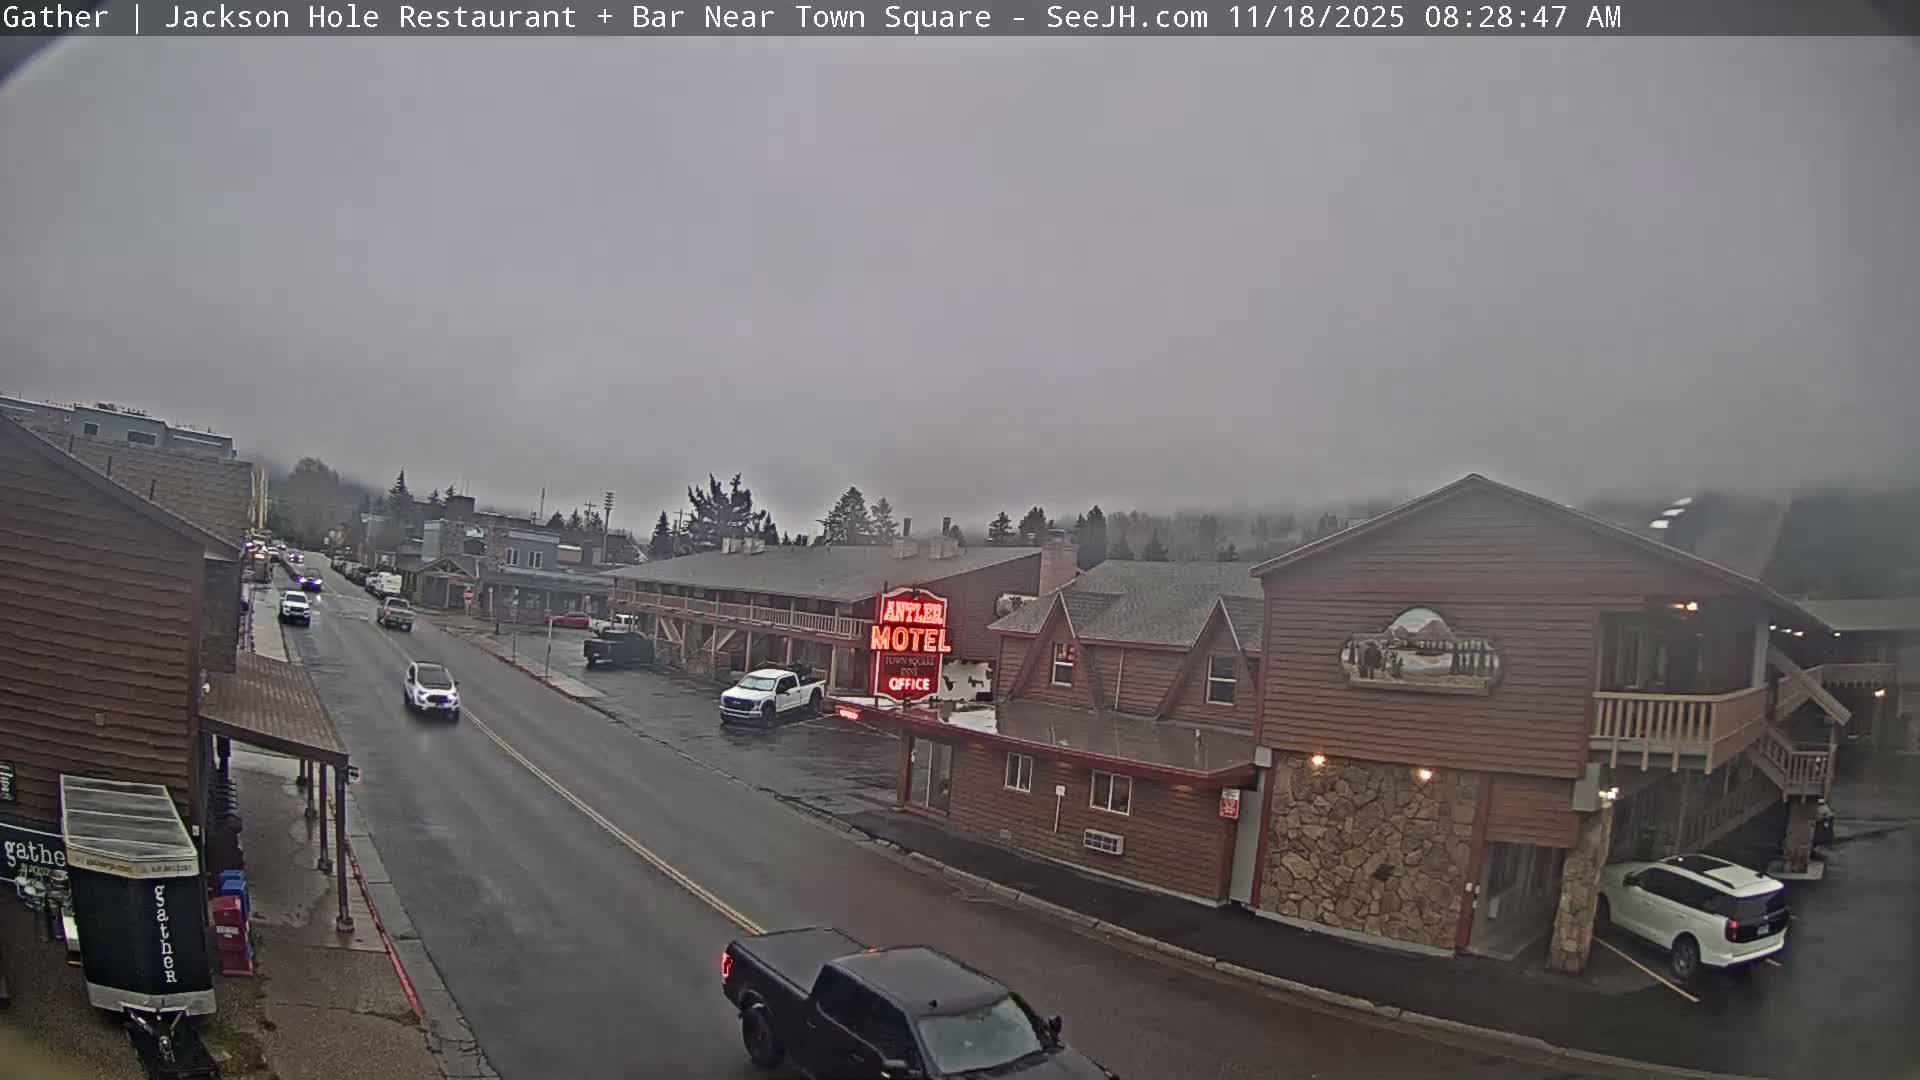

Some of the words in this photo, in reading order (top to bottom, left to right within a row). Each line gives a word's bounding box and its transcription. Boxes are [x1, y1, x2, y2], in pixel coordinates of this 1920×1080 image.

[883, 601, 943, 624] ANTLER
[871, 625, 952, 652] MOTEL
[884, 656, 907, 665] TOWN
[888, 677, 931, 691] OFFICE
[4, 840, 66, 867] gathe
